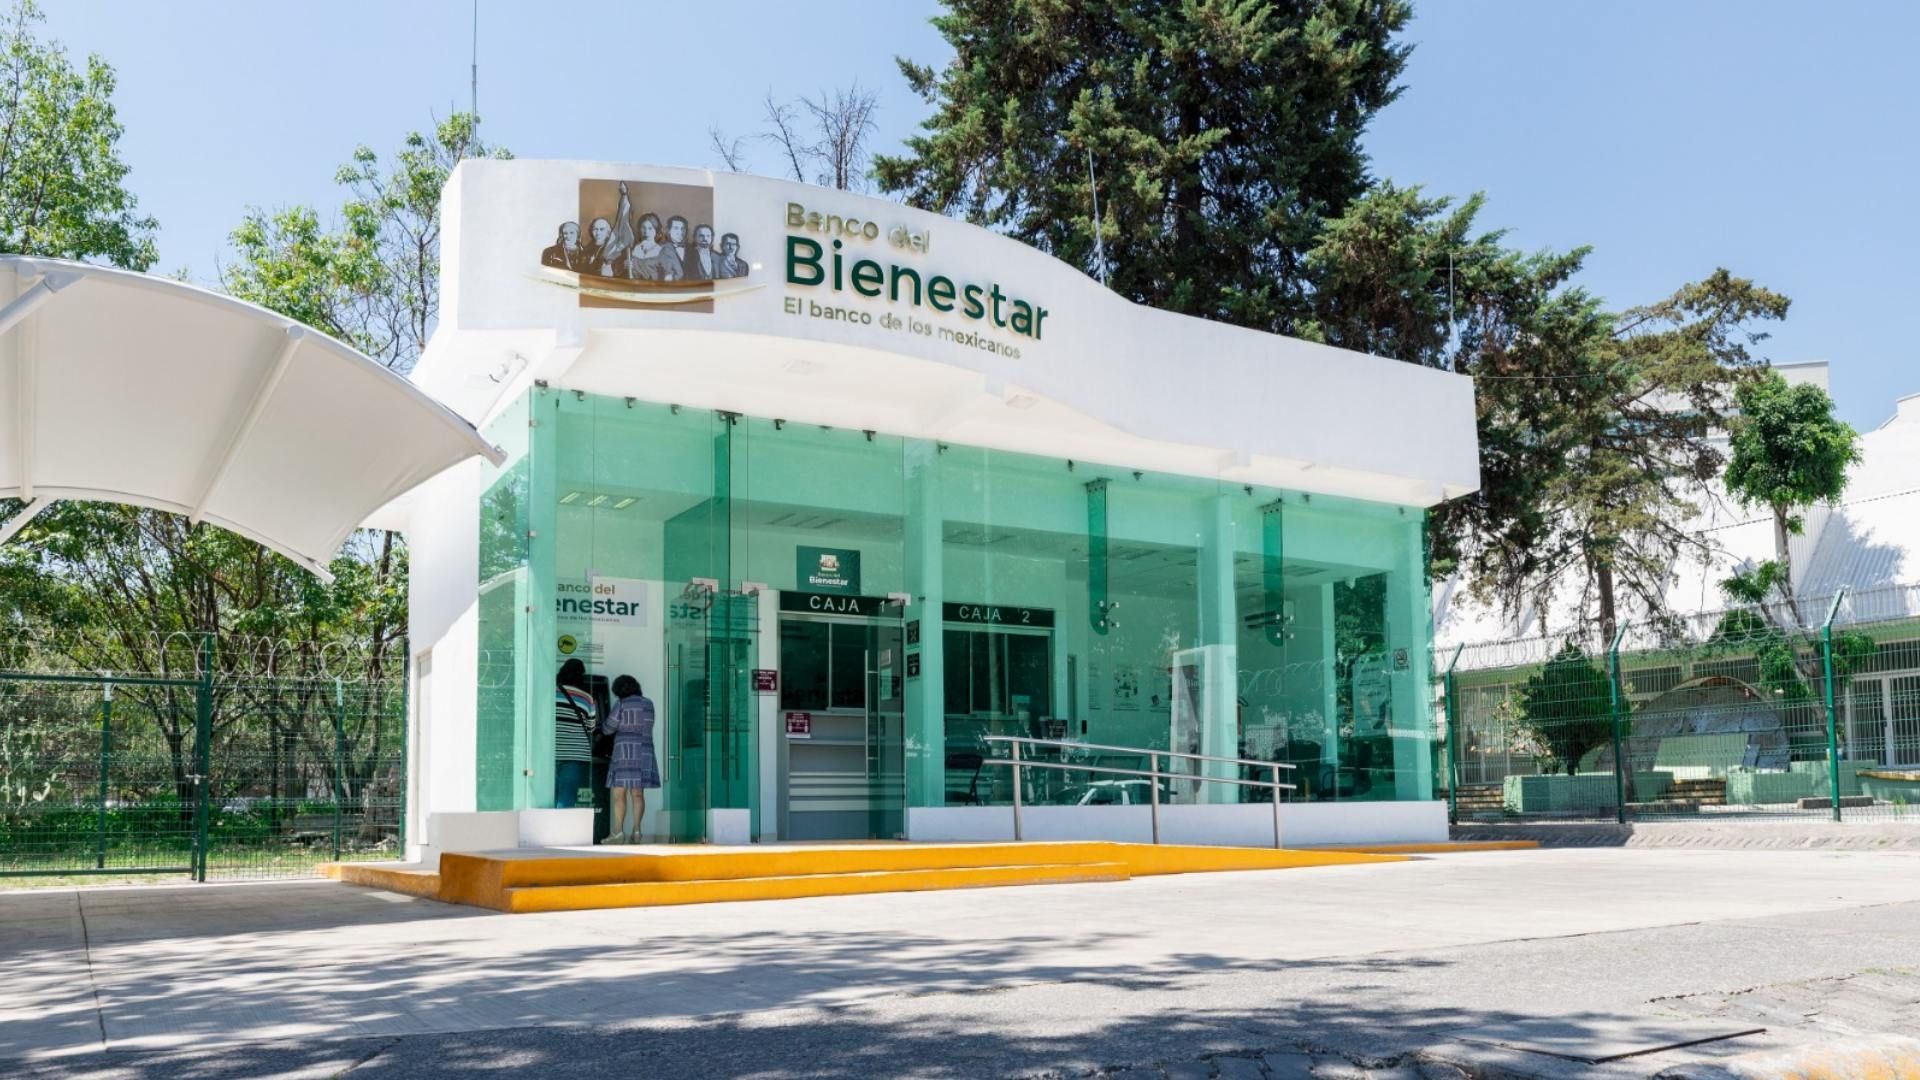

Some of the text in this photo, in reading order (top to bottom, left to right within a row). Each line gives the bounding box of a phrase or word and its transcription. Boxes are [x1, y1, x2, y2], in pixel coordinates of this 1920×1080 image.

[785, 202, 930, 254] Banco del
[786, 235, 1049, 340] Bienestar
[784, 296, 1021, 360] El banco de los mexicanos
[557, 583, 616, 595] anco del
[809, 575, 849, 586] Bienestar
[556, 597, 640, 616] nestar
[809, 595, 885, 613] CAJA 1
[959, 605, 1031, 624] CAJA 2
